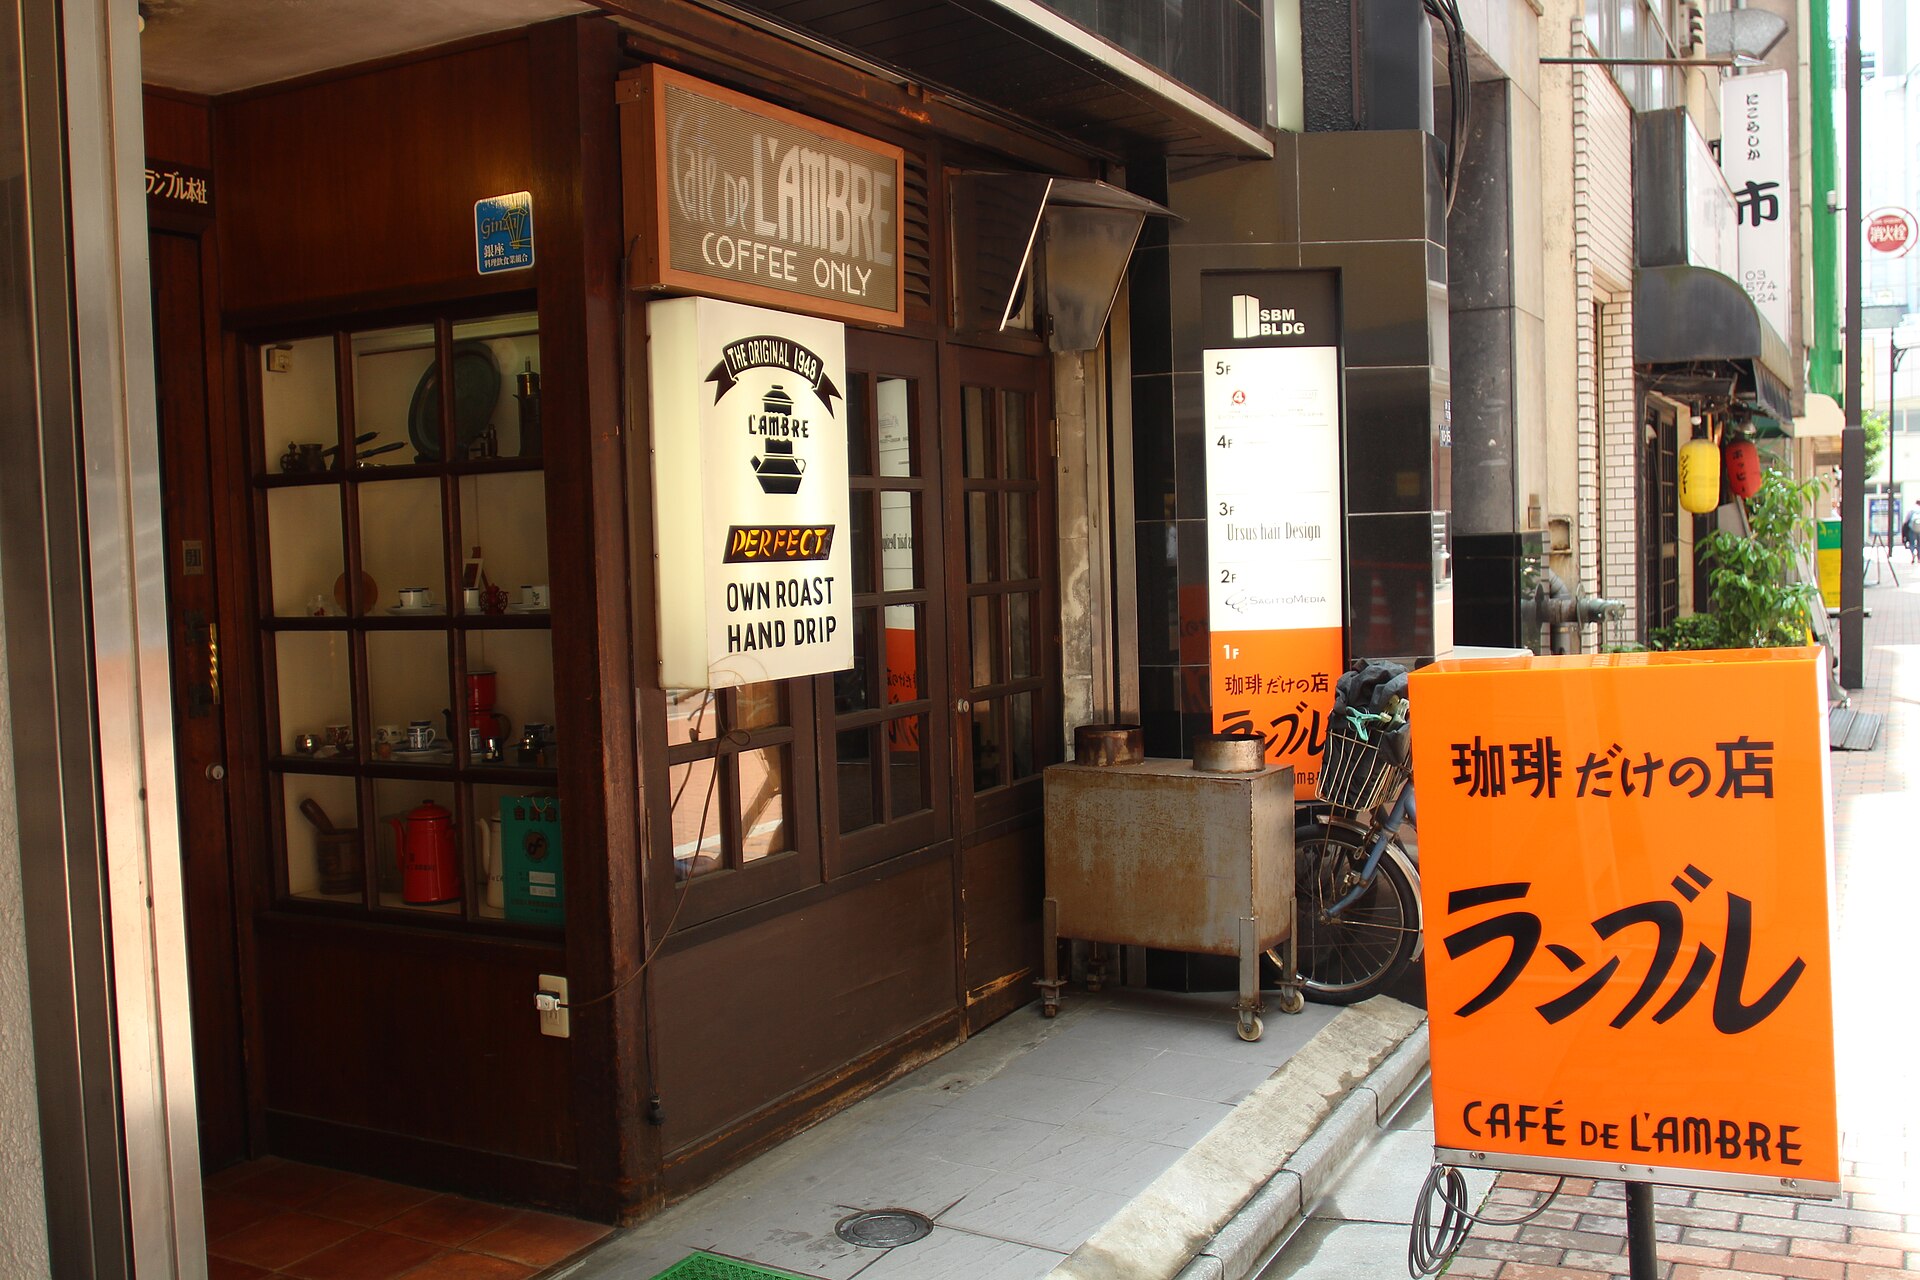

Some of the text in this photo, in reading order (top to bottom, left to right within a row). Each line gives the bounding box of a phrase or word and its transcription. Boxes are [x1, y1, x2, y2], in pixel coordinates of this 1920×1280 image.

[1734, 180, 1779, 227] 市
[1869, 223, 1907, 244] 消火栓
[701, 231, 872, 297] COFFEE ONLY
[1260, 308, 1296, 322] SBM
[1260, 322, 1306, 336] BLDG
[727, 339, 817, 380] THE ORIGINAL 1948
[1215, 361, 1232, 376] 5F
[747, 414, 810, 439] L'AMBRE
[1217, 434, 1233, 449] 4F
[1218, 502, 1236, 517] 3F
[1285, 521, 1322, 541] Design
[1220, 569, 1237, 584] 2F
[727, 576, 835, 613] OWN ROAST
[727, 615, 837, 654] HAND DRIP
[1223, 644, 1240, 660] 1F
[1225, 672, 1329, 696] 珈琲だけの店
[1450, 735, 1775, 800] 珈琲だけの店
[1443, 863, 1807, 1035] ランブル
[1462, 1100, 1803, 1167] CAFÉ DE L'AMBRE
